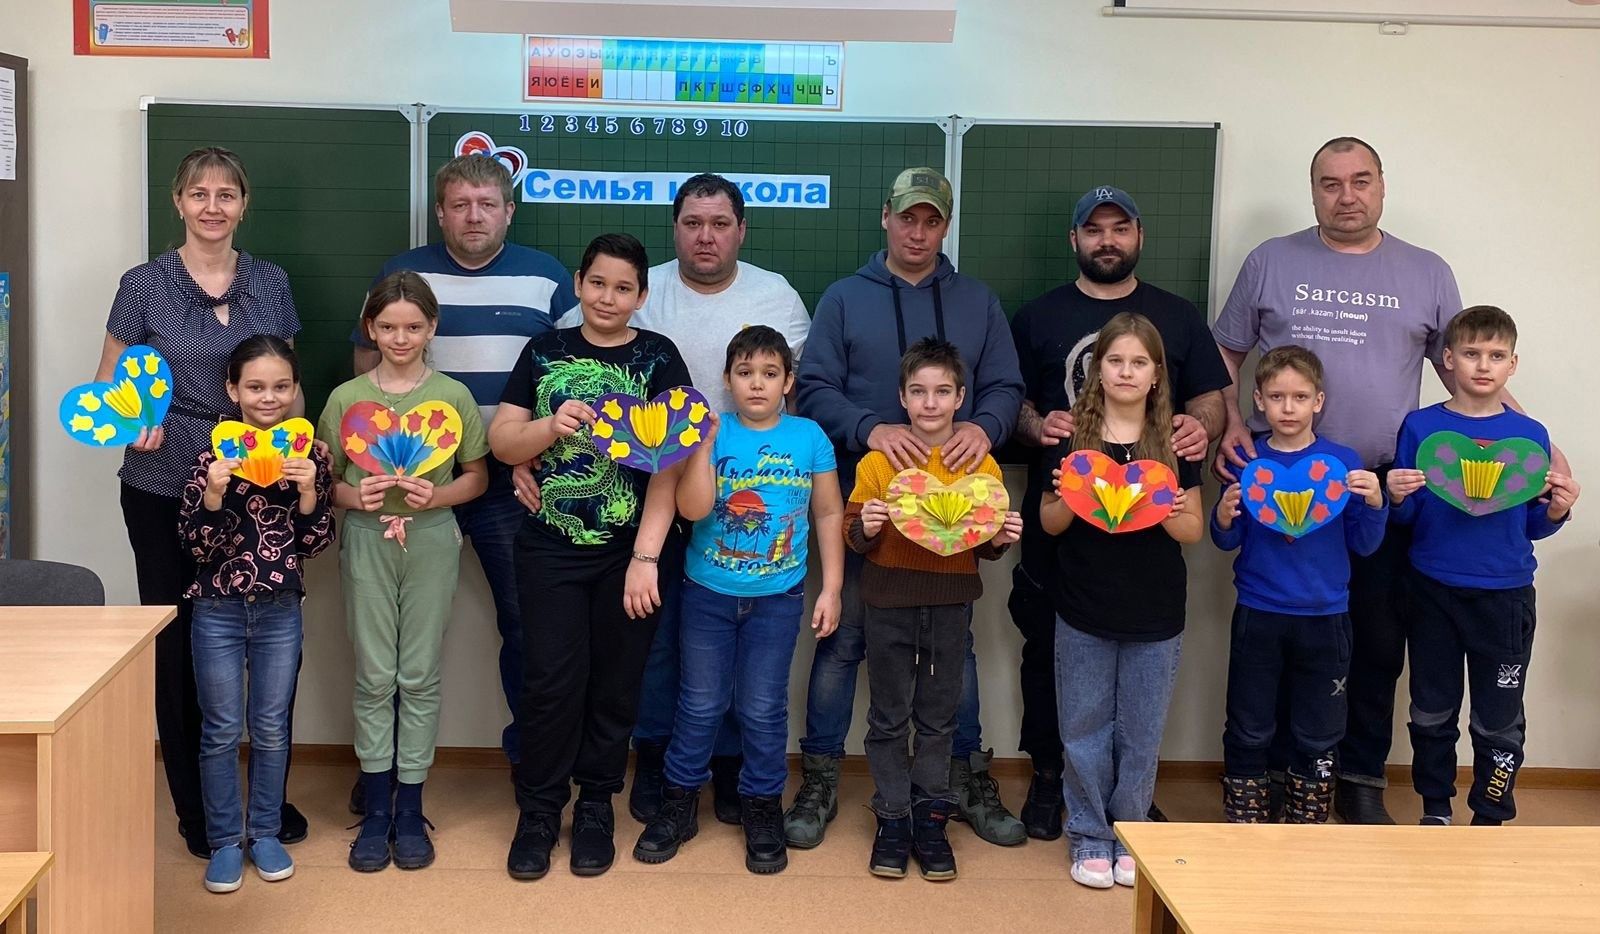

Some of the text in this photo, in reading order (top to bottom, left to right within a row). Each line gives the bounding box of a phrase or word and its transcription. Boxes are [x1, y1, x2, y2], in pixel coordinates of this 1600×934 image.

[520, 115, 749, 137] 1 2 3 4 5 6 7 8 9 10
[524, 170, 653, 201] Семья
[738, 181, 827, 204] кола
[1095, 188, 1113, 201] LA
[1295, 283, 1401, 309] Sarcasm
[1340, 311, 1369, 322] (noun)
[1302, 325, 1322, 334] ability
[1314, 333, 1331, 341] them
[757, 444, 794, 469] San
